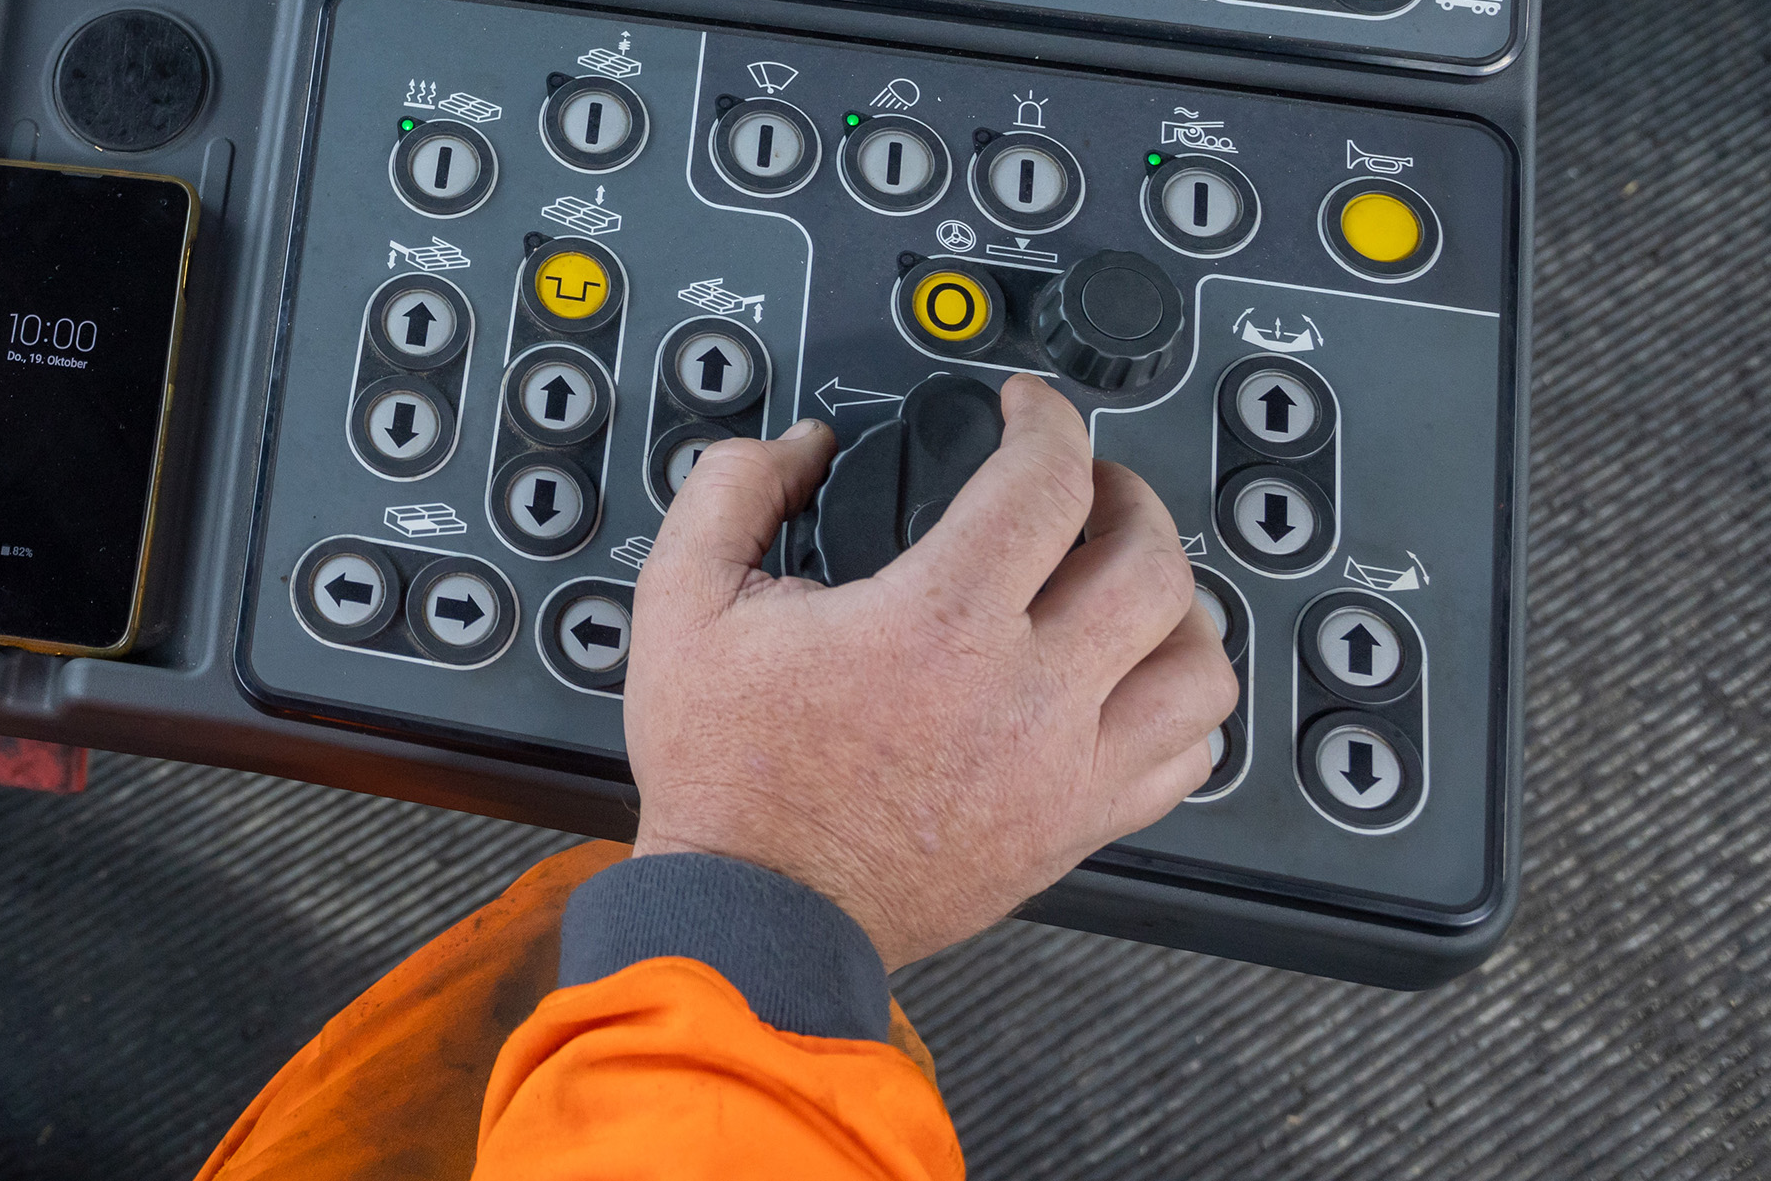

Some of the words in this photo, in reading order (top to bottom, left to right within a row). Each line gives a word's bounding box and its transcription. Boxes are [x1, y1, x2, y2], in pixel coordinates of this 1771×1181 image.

[10, 313, 98, 353] 10:00
[7, 350, 27, 364] Do.,
[29, 353, 44, 365] 19.
[47, 355, 88, 369] Oktober
